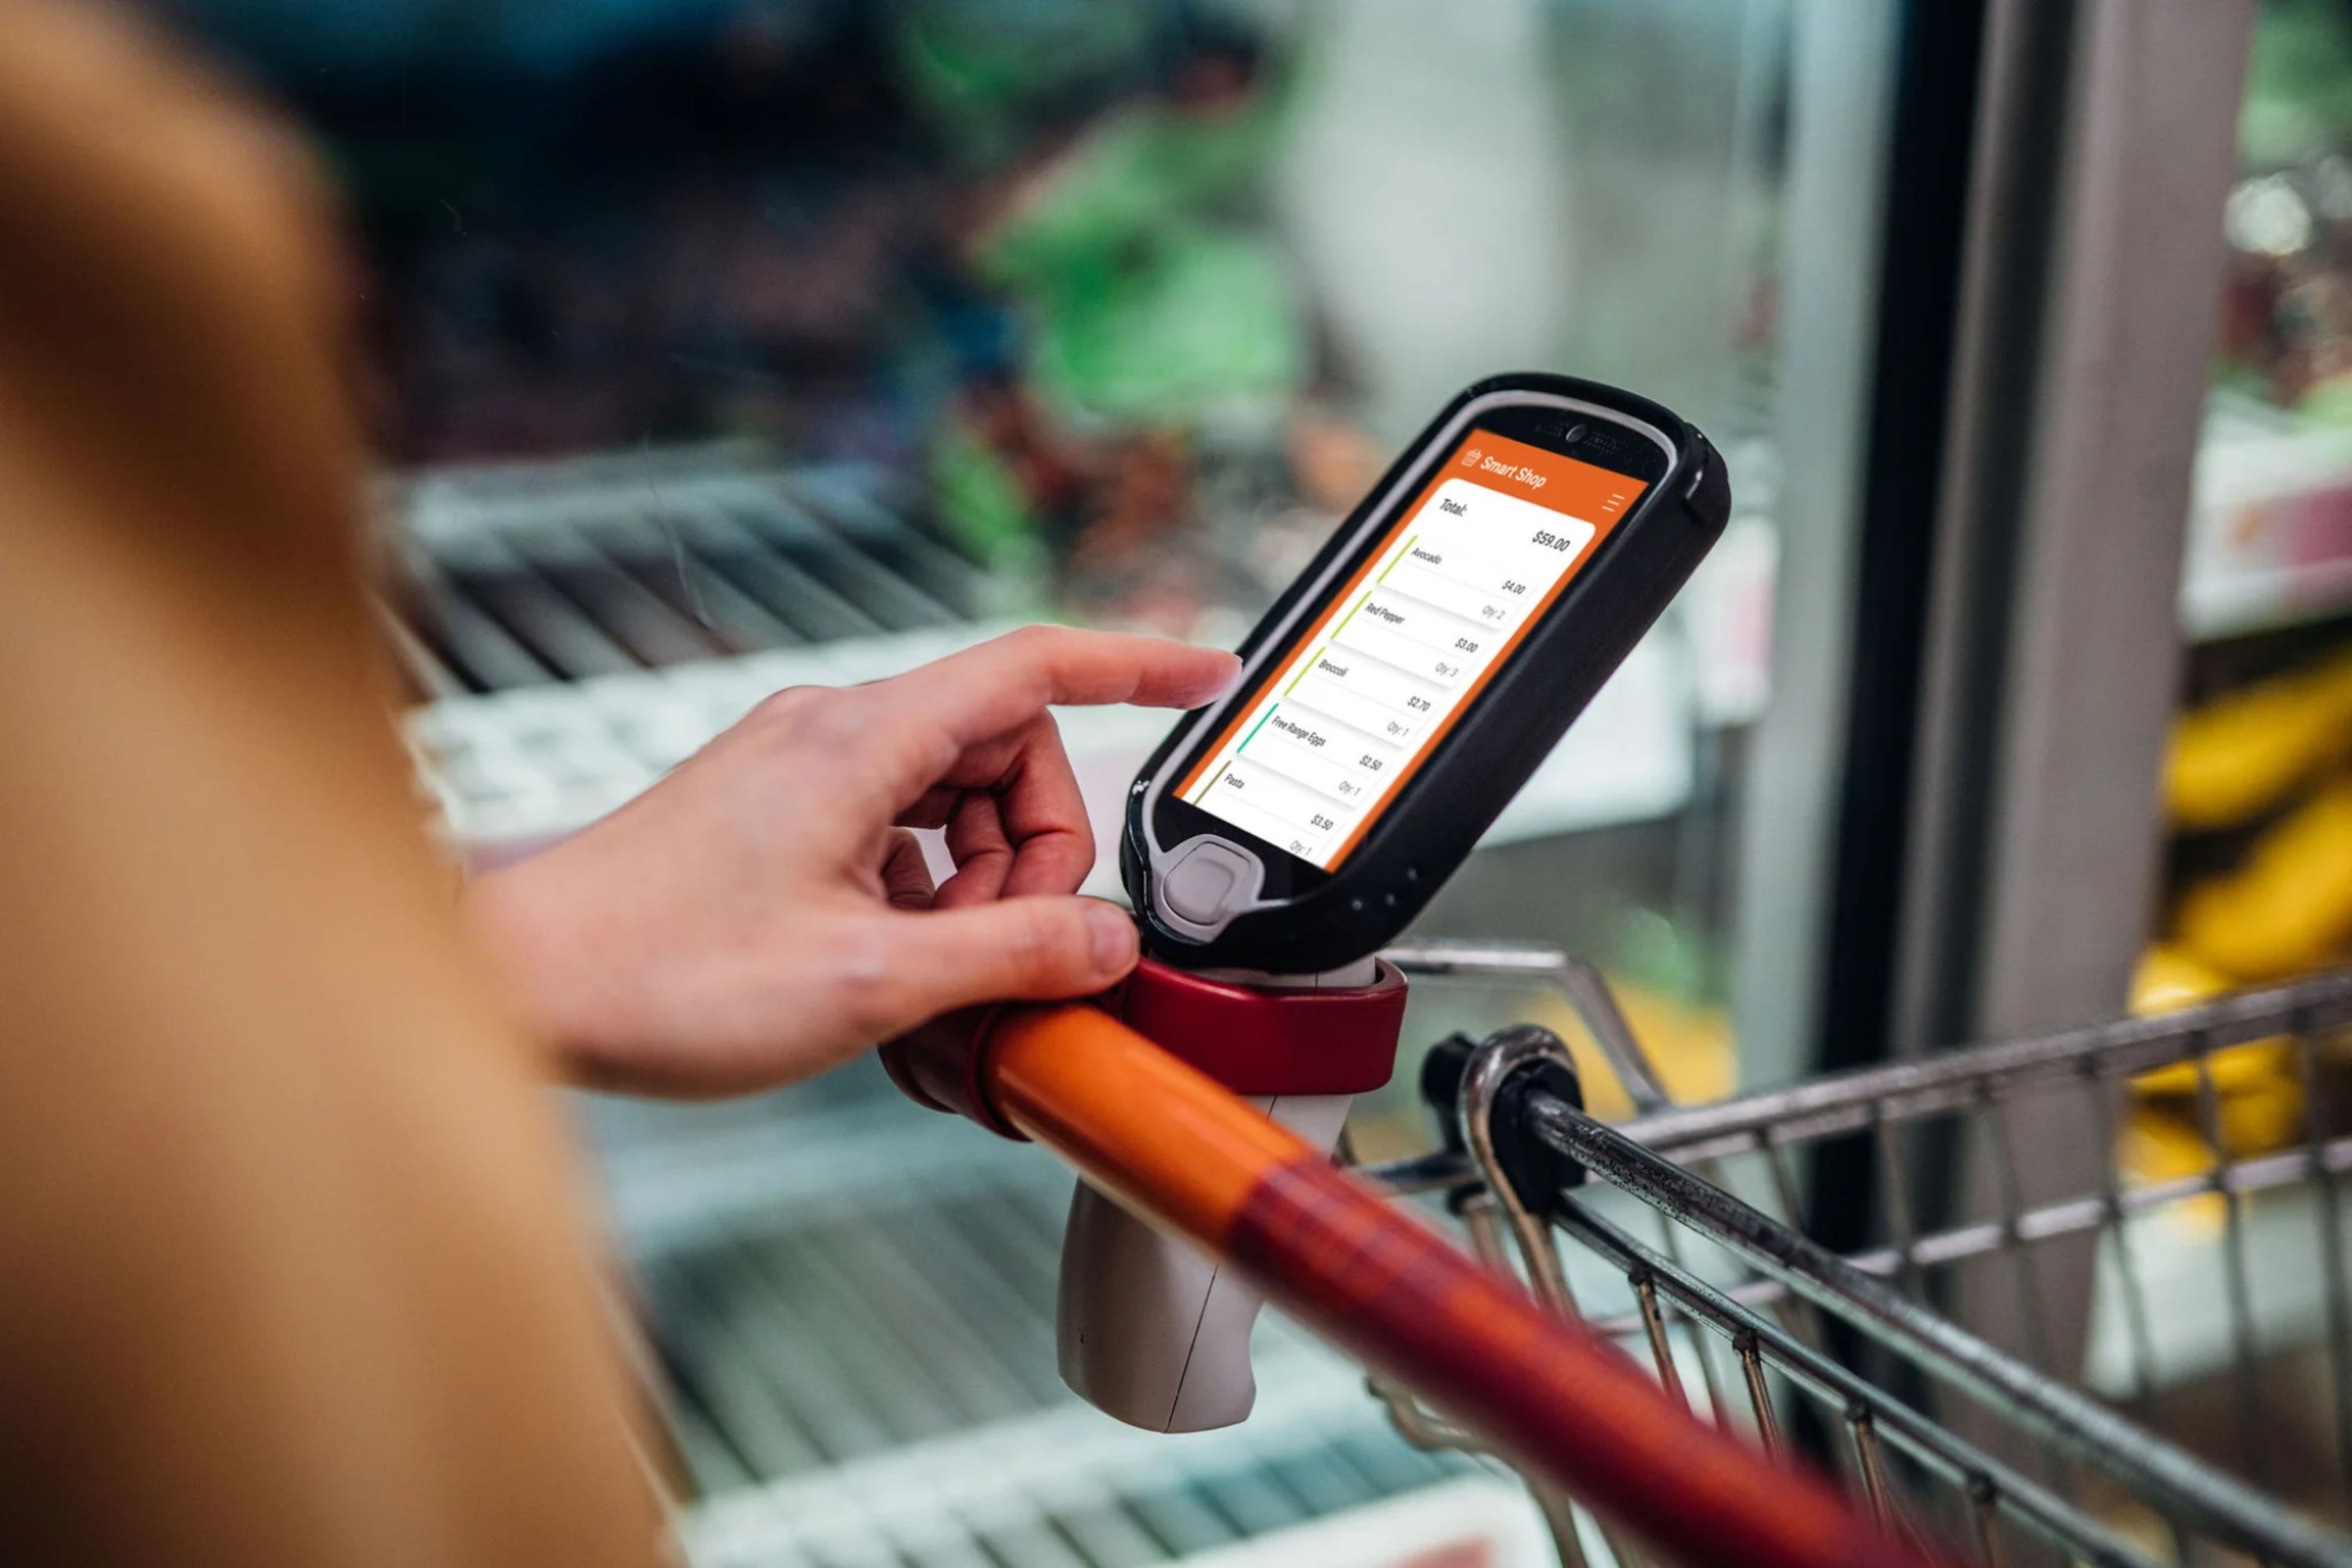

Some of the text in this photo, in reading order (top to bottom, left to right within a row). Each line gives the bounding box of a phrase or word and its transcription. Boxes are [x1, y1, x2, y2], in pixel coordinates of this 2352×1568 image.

[1480, 456, 1547, 490] Smart Shop
[1439, 498, 1468, 517] Total:
[1532, 530, 1571, 552] $59.00
[1411, 547, 1442, 564] Avocado
[1501, 580, 1526, 595] $4.00
[1365, 602, 1405, 624] Red Pepper
[1496, 610, 1506, 620] 2
[1454, 637, 1479, 653] $3.00
[1318, 659, 1348, 677] Broccoli
[1450, 667, 1459, 677] 3
[1406, 695, 1431, 712] $2.70
[1271, 715, 1327, 747] Free Range Eggs
[1401, 728, 1410, 737] 1
[1359, 754, 1383, 771] $2.50
[1224, 773, 1246, 789] Pasta
[1352, 786, 1361, 797] 1
[1310, 814, 1334, 831] $3.50
[1304, 847, 1312, 857] 1
